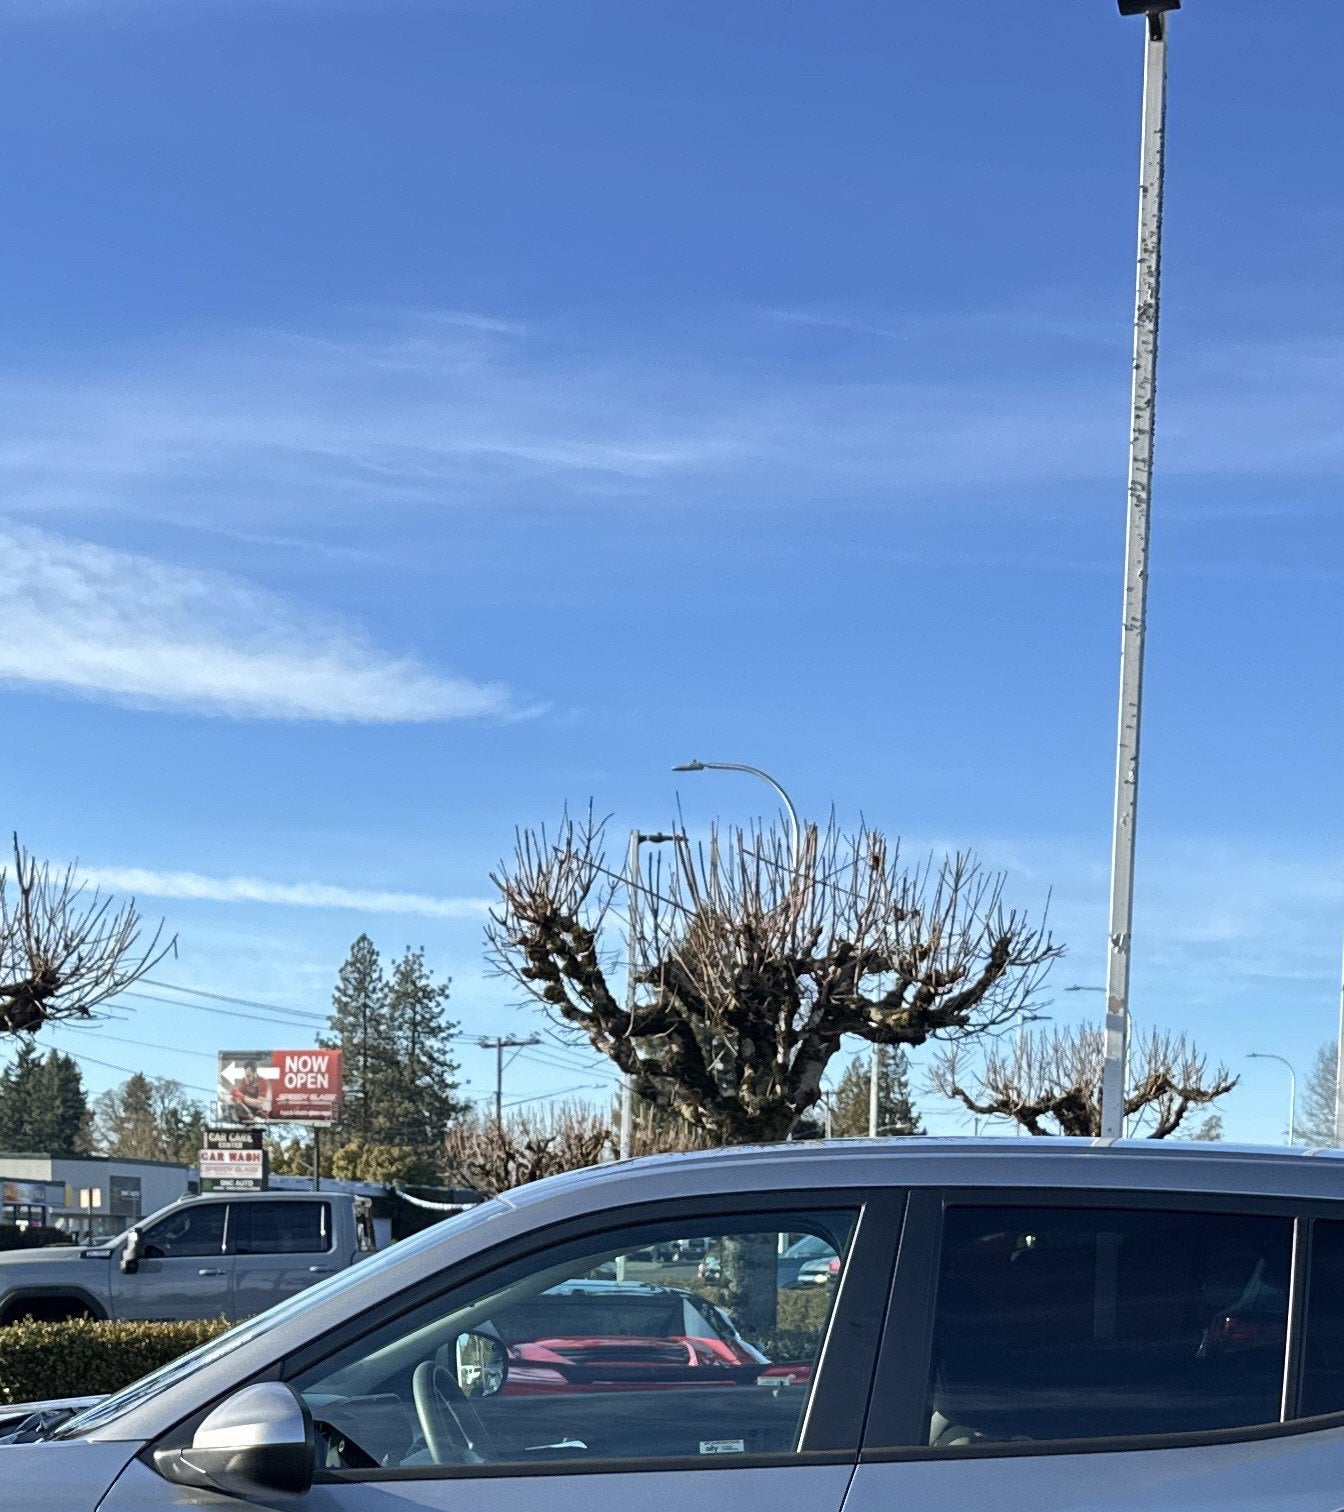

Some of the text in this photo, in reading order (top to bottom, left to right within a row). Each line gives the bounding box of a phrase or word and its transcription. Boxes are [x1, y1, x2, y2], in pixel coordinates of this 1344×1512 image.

[284, 1055, 329, 1073] NOW
[284, 1072, 329, 1089] OPEN
[208, 1132, 254, 1142] CAR CARE
[201, 1152, 261, 1162] CAR WASH
